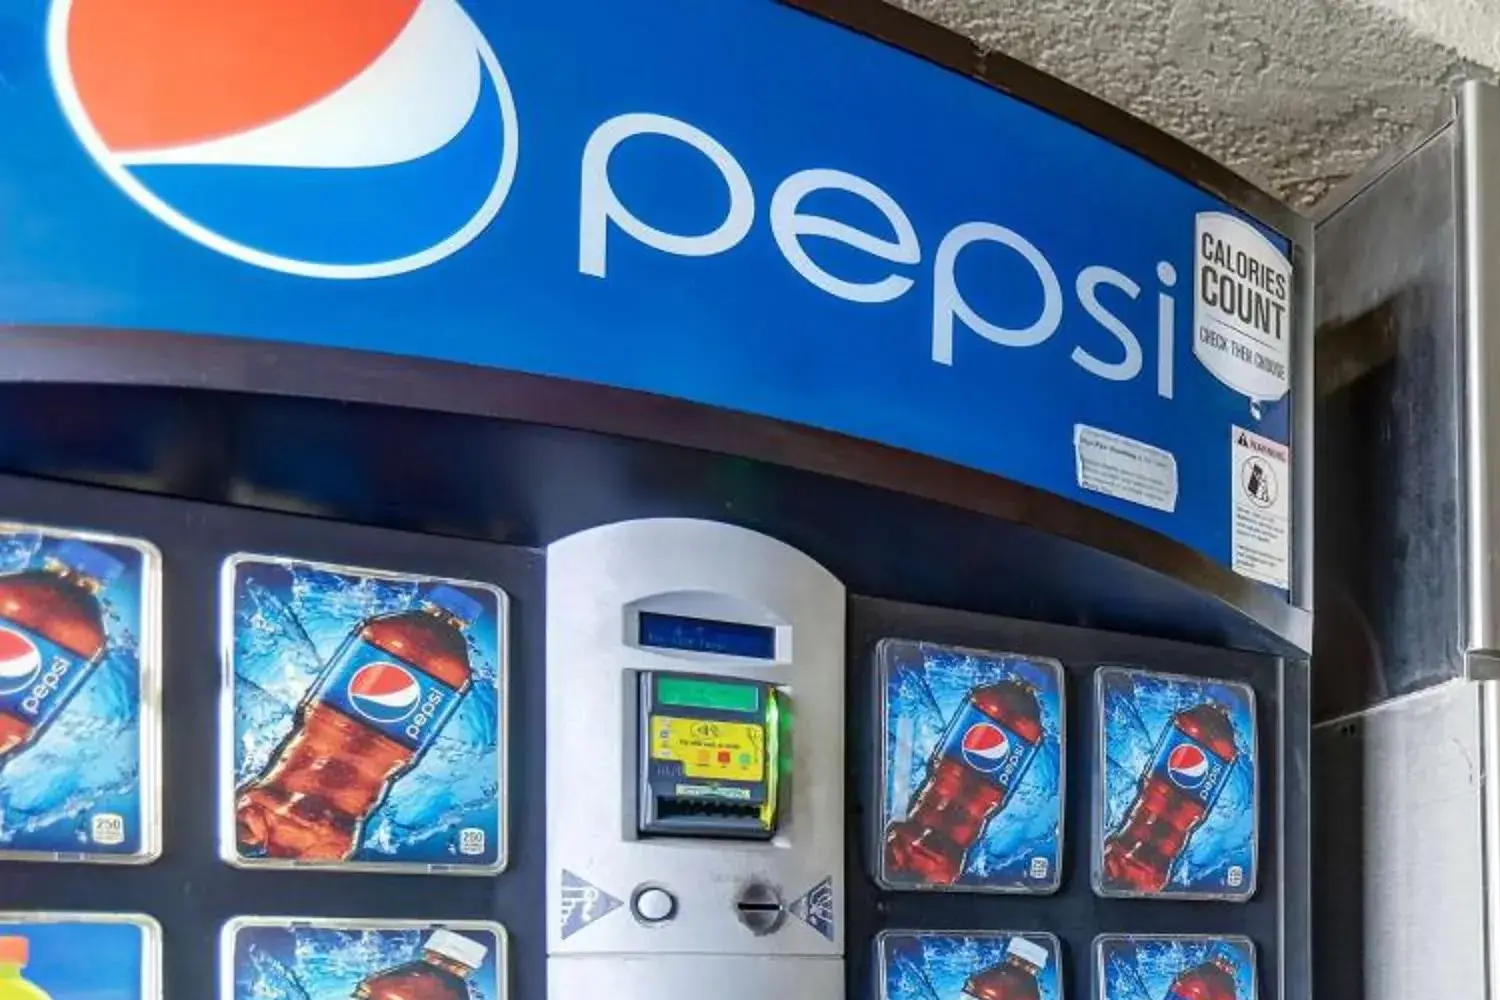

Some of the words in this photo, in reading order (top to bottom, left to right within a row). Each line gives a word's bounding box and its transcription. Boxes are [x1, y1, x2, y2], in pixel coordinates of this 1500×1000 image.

[579, 113, 1177, 400] pepsi
[1201, 231, 1286, 300] CALORIES
[1201, 265, 1286, 340] COUNT
[1200, 326, 1227, 351] CHECK
[1231, 340, 1252, 364] THEN
[21, 655, 73, 715] pepsi
[405, 687, 445, 741] pepsi
[1000, 744, 1025, 787] pepsi
[1199, 761, 1222, 801] pepsi
